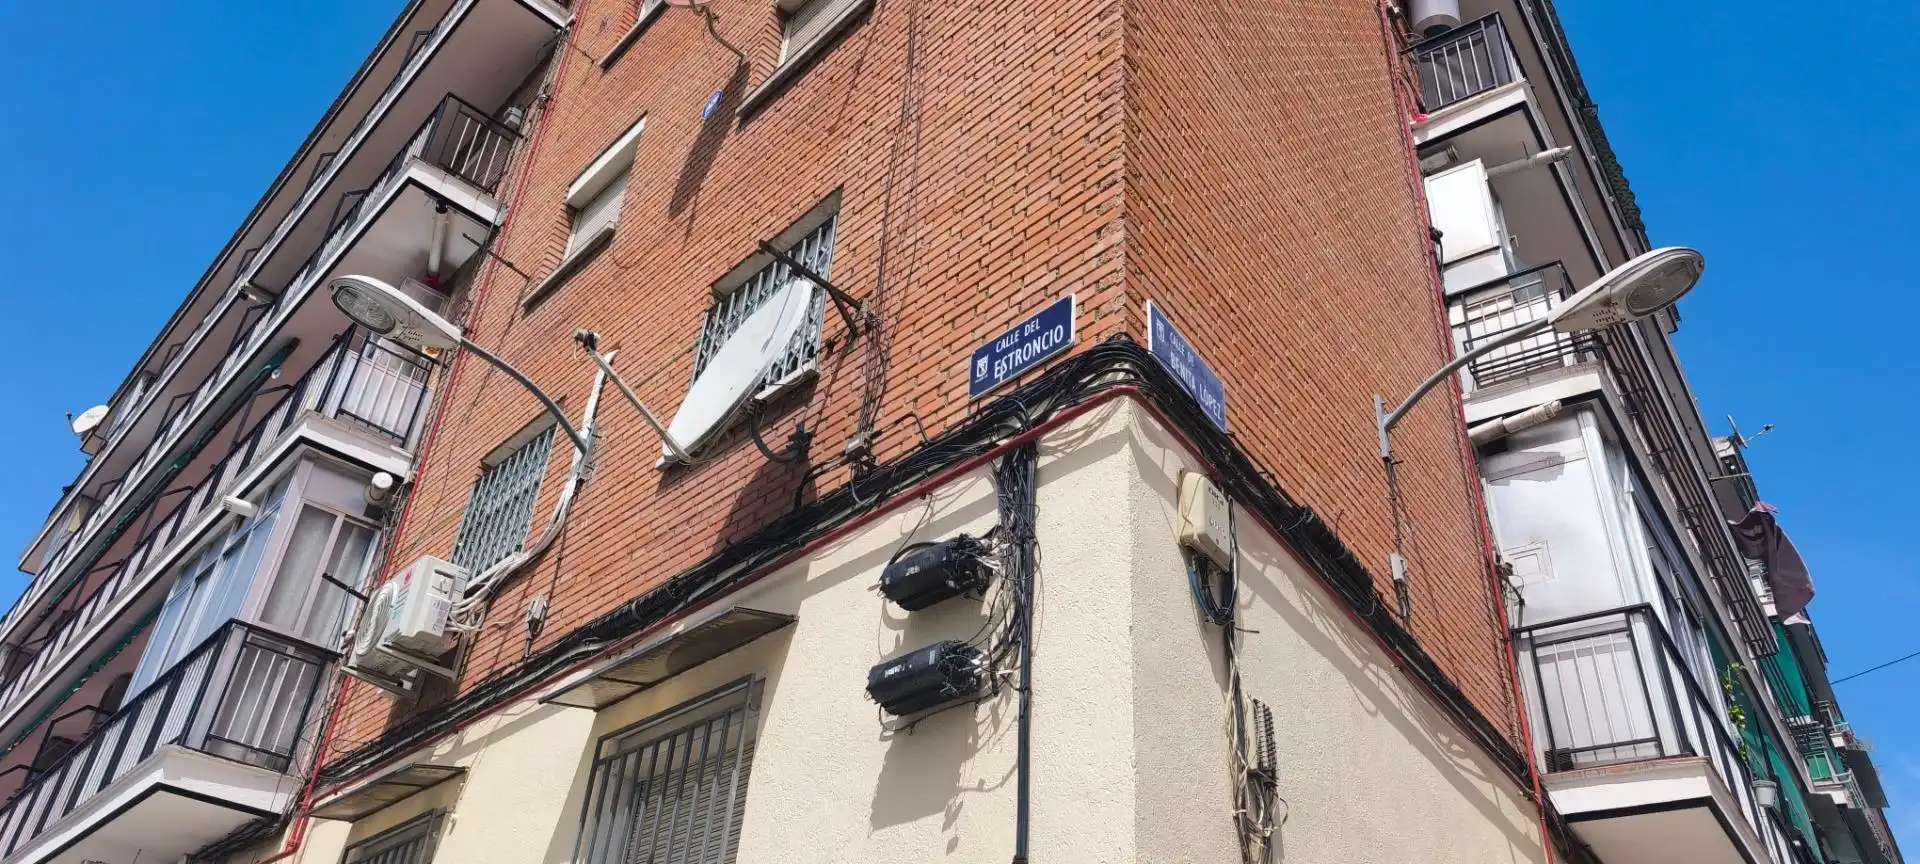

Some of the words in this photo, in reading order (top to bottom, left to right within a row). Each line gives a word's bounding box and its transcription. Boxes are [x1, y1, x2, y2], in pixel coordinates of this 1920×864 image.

[994, 324, 1064, 380] ESTRONCIO
[995, 329, 1021, 353] CALLE
[1024, 318, 1041, 337] DEL
[1169, 331, 1185, 357] CALLE
[1187, 351, 1195, 368] DE
[1170, 350, 1197, 395] BENITA
[1199, 383, 1223, 421] LÓPEZ
